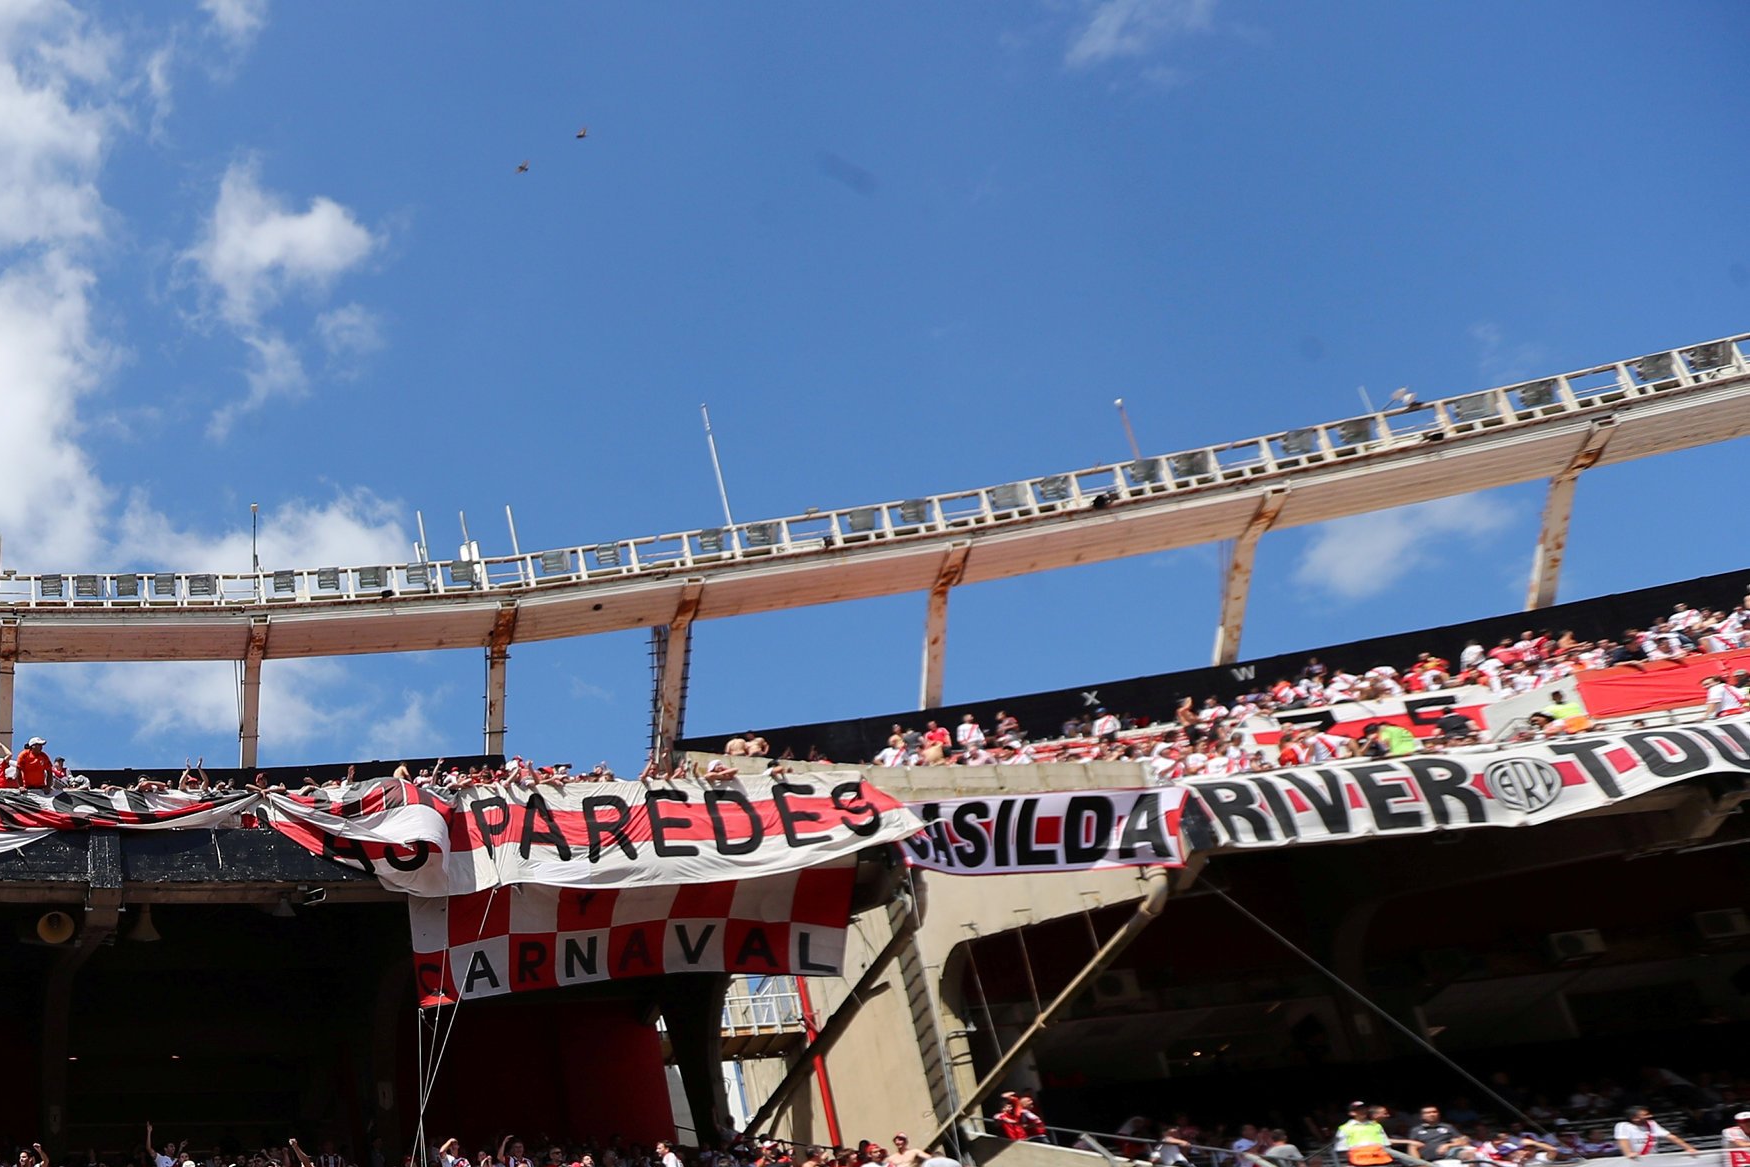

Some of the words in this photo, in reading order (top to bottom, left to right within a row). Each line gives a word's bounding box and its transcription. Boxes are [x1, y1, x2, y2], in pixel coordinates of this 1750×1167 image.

[471, 780, 882, 864] PAREDES
[1192, 756, 1488, 844] RIVER
[415, 923, 838, 995] CARNAVAL
